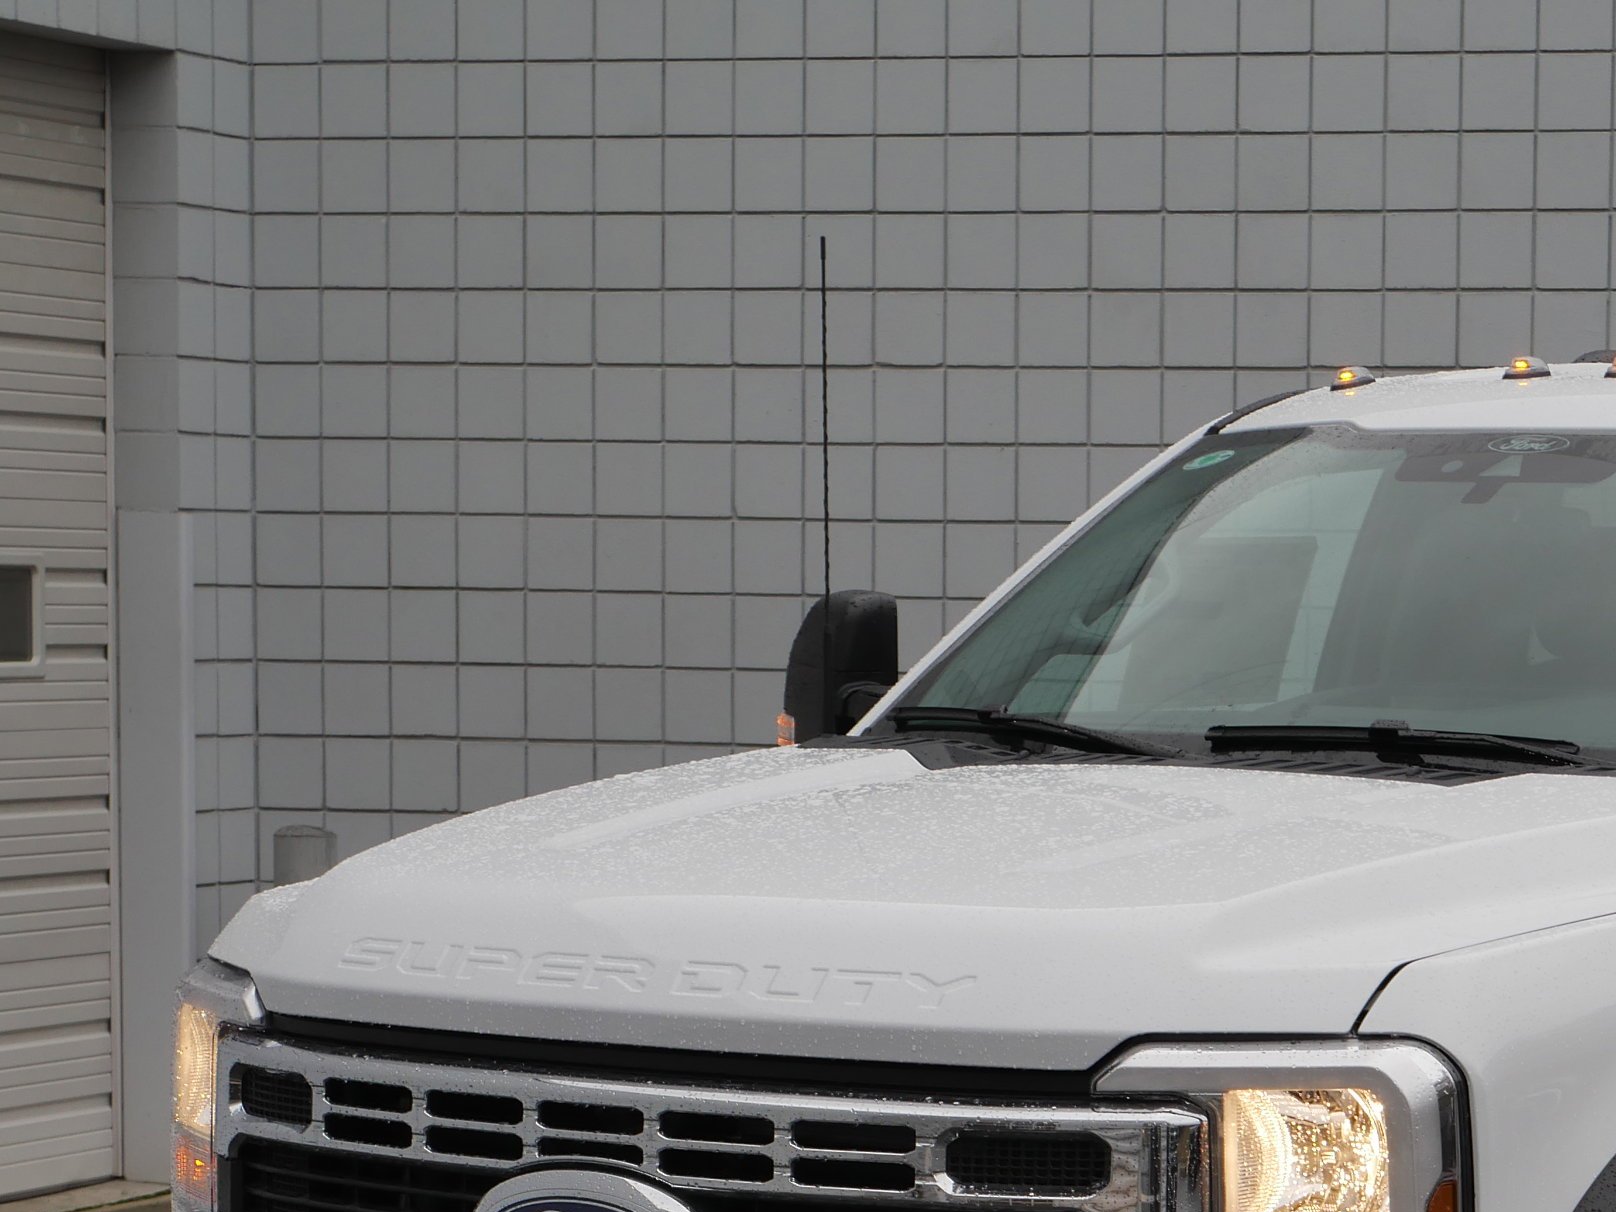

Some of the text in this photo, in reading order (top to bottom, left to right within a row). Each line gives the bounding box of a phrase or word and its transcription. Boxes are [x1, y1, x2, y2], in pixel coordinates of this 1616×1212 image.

[1499, 437, 1557, 451] Ford
[337, 935, 978, 1010] SUPER DUTY
